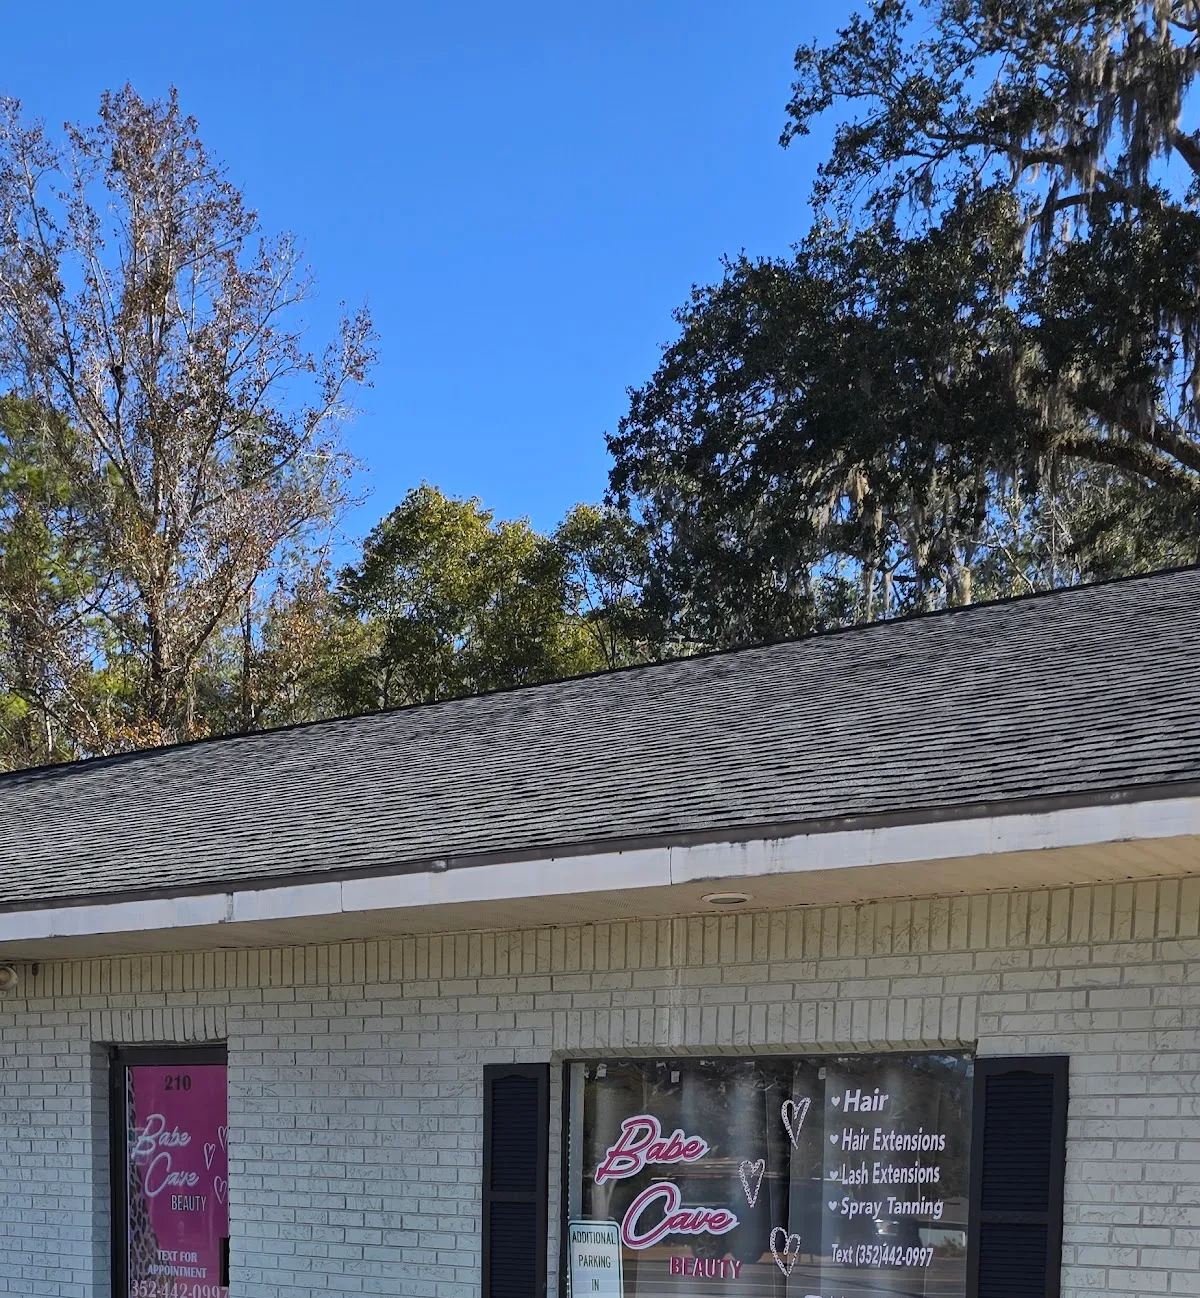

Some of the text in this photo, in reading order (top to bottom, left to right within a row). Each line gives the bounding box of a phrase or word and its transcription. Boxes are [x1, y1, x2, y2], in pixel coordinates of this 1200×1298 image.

[164, 1075, 192, 1091] 210
[843, 1088, 889, 1112] Hair
[131, 1113, 192, 1160] Babe
[841, 1127, 946, 1151] Hair Extensions
[595, 1114, 711, 1185] Babe
[144, 1151, 200, 1198] Cave
[841, 1161, 940, 1185] Lash Extensions
[171, 1194, 207, 1212] BEAUTY
[840, 1197, 944, 1220] Spray Tanning
[621, 1182, 740, 1250] Cave
[571, 1230, 617, 1245] ADDITIONAL
[157, 1250, 198, 1263] TEXT FOR
[578, 1255, 611, 1269] PARKING
[831, 1243, 934, 1268] Text (352)442-0997
[147, 1265, 208, 1279] APPOINTMENT
[669, 1256, 744, 1280] BEAUTY
[591, 1278, 600, 1291] IN
